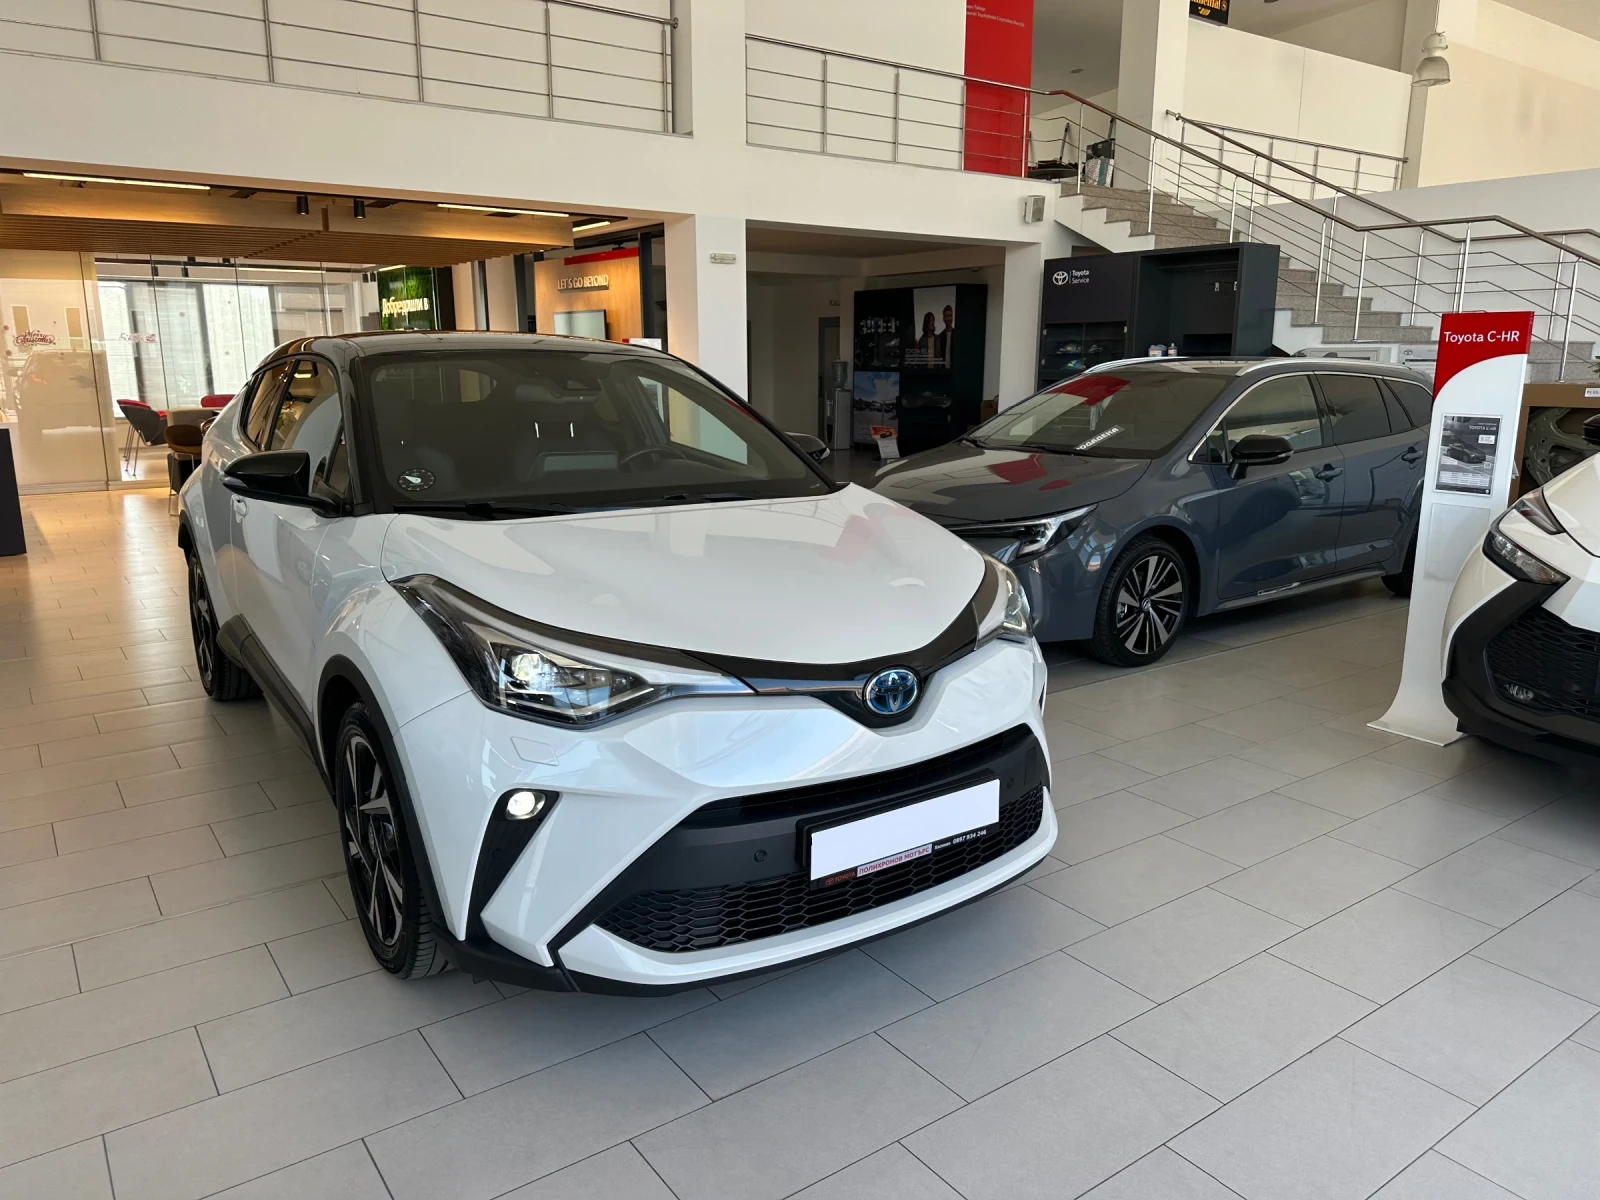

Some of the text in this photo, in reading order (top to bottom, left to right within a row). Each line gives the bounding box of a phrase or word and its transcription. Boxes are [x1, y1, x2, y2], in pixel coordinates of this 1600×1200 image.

[573, 277, 583, 288] GO
[584, 275, 609, 287] BEYOND
[1444, 330, 1520, 345] Toyota C-HR
[859, 846, 930, 875] ПОЛИХРОНОВ МОТЪРС
[835, 871, 856, 882] TOYOTA
